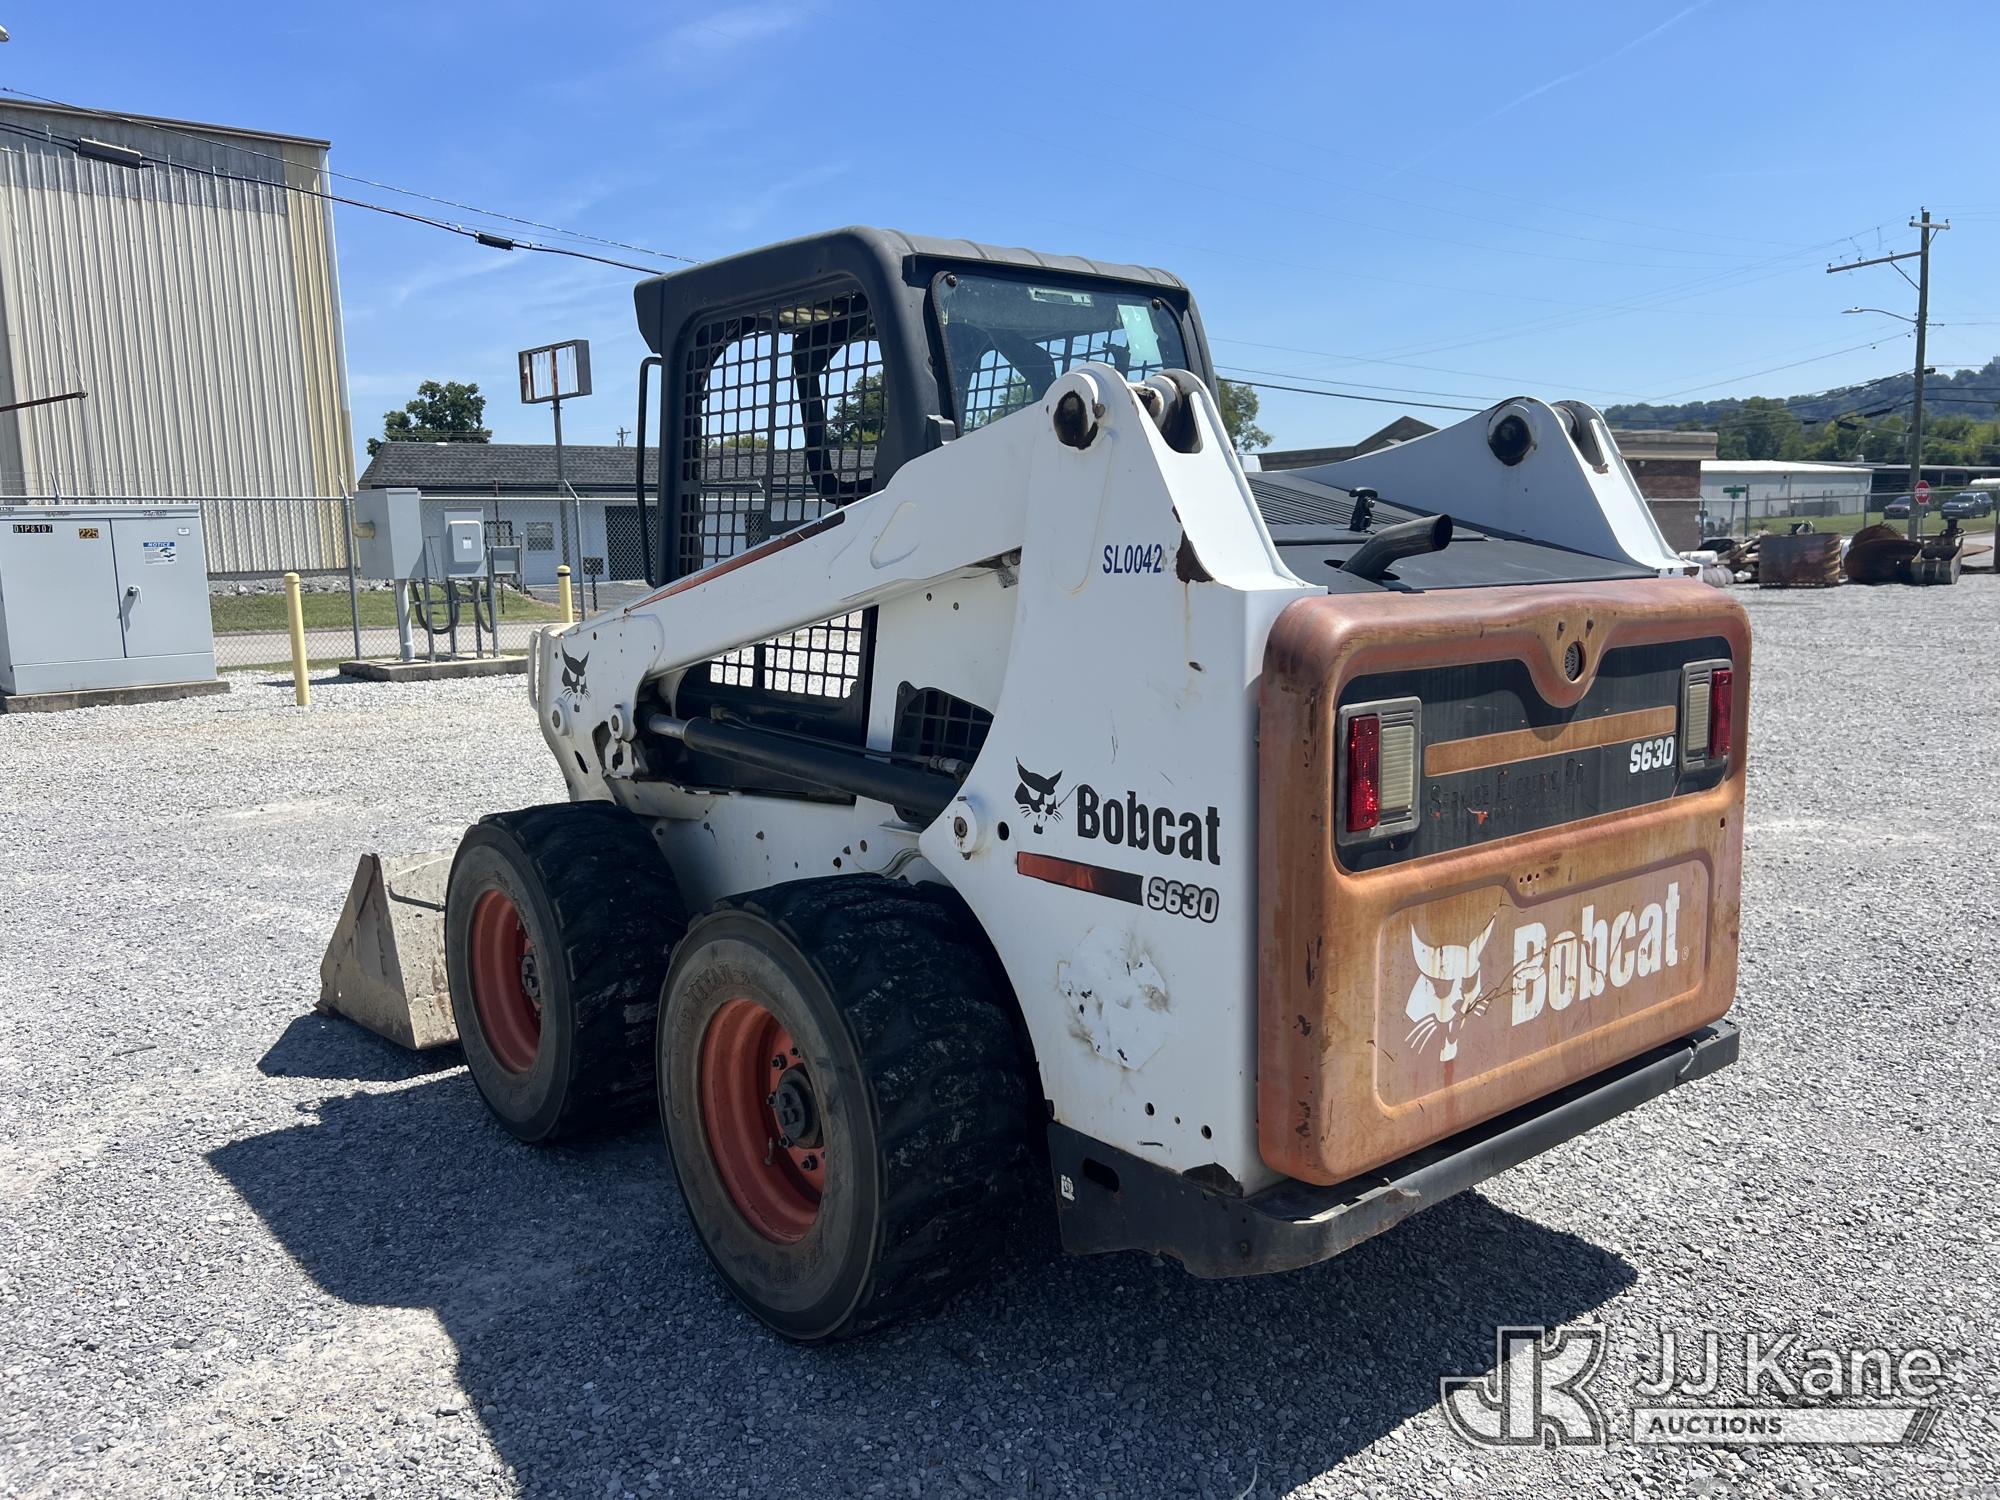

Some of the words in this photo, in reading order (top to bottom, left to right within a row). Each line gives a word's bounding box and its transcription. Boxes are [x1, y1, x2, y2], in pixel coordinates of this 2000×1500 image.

[80, 529, 98, 538] 225
[1103, 544, 1162, 574] SL0042
[1630, 736, 1675, 773] S630
[1077, 783, 1221, 866] Bobcat
[1147, 876, 1219, 923] S630
[1512, 882, 1681, 1026] Bobcat
